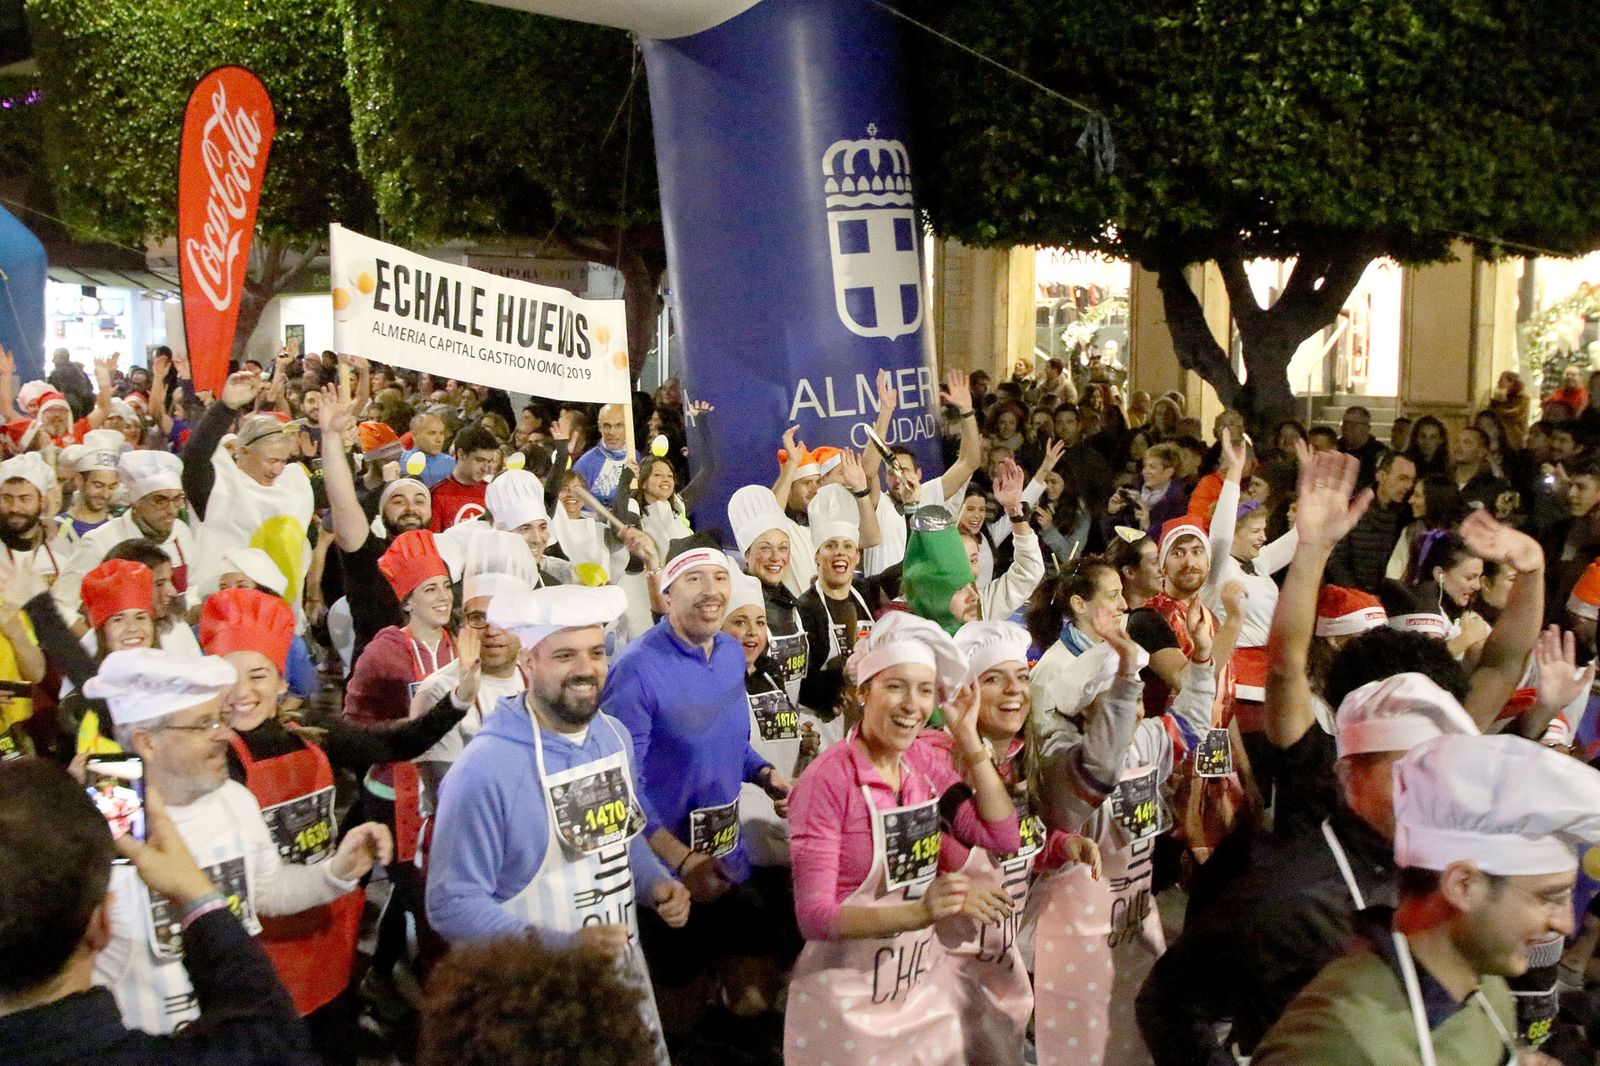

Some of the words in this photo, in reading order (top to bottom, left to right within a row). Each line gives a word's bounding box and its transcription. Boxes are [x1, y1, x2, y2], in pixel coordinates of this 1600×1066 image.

[373, 258, 486, 338] ECHALE
[372, 320, 427, 346] ALMERIA
[429, 335, 476, 359] CAPITAL
[566, 366, 592, 380] 2019
[850, 413, 936, 449] CUDAD
[775, 711, 799, 727] 1874
[584, 799, 628, 831] 1470
